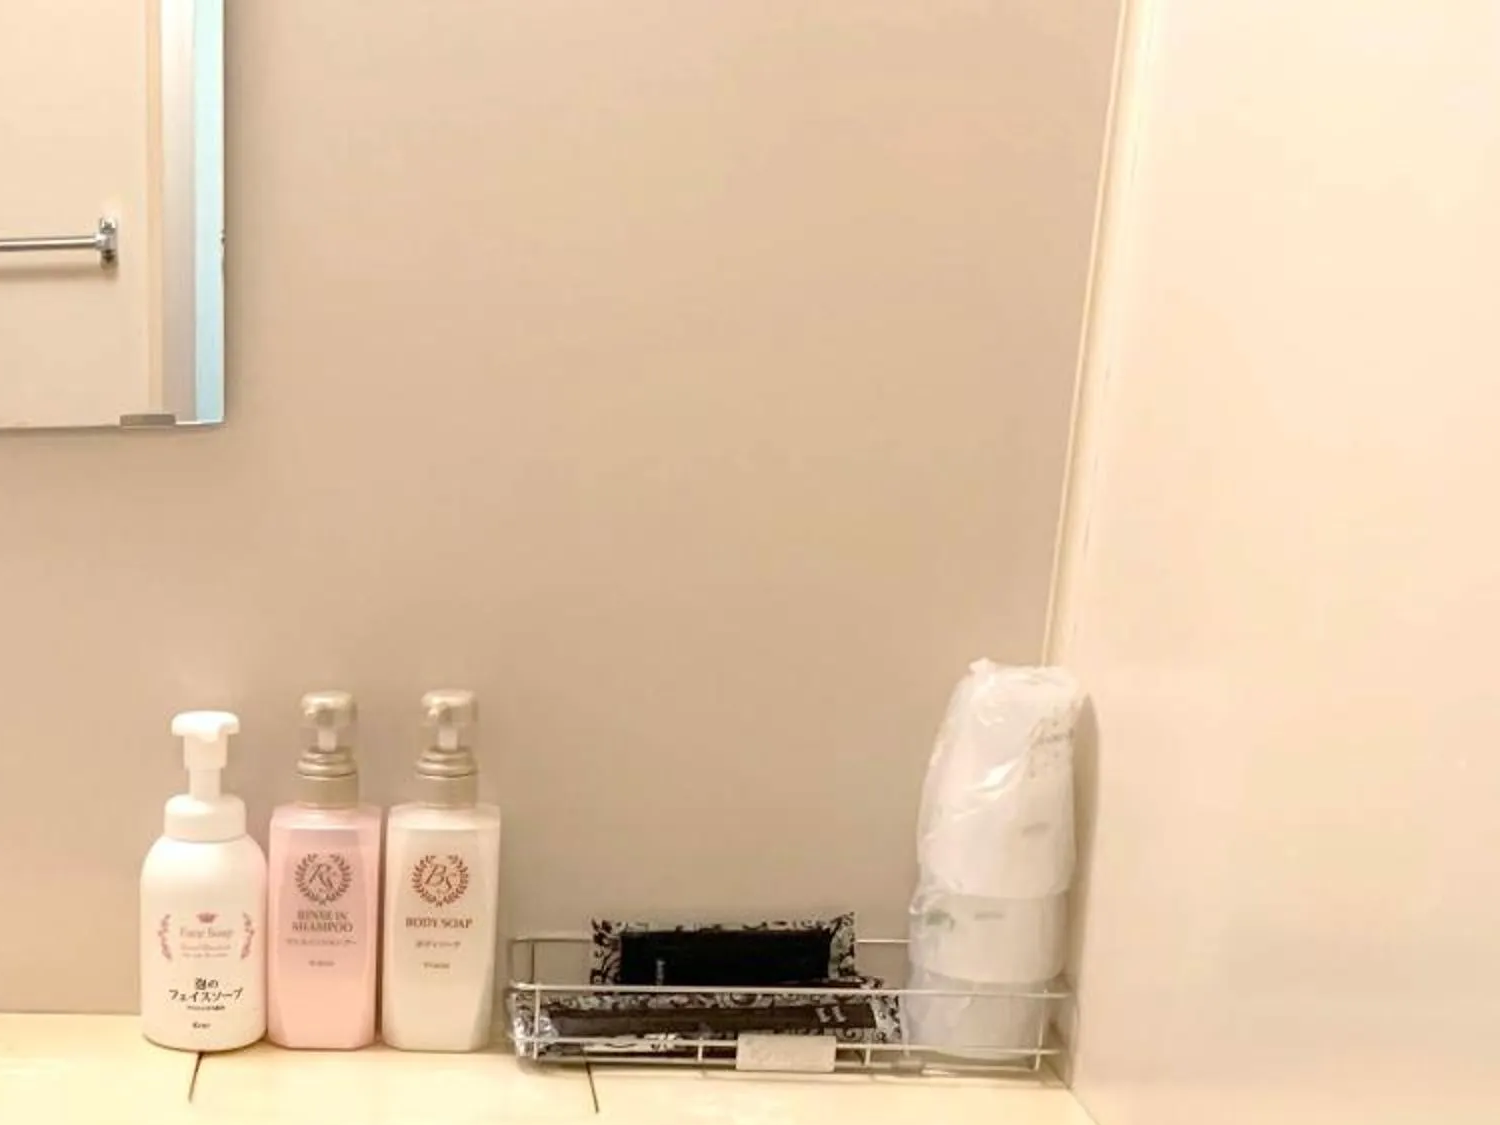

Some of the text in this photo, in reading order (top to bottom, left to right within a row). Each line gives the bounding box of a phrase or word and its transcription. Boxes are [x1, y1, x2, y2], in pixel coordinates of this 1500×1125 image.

[292, 921, 353, 932] SHAMPOO
[405, 917, 473, 928] BODY SOAP
[195, 977, 219, 990] 泡の
[168, 987, 243, 1003] フェイスソープ
